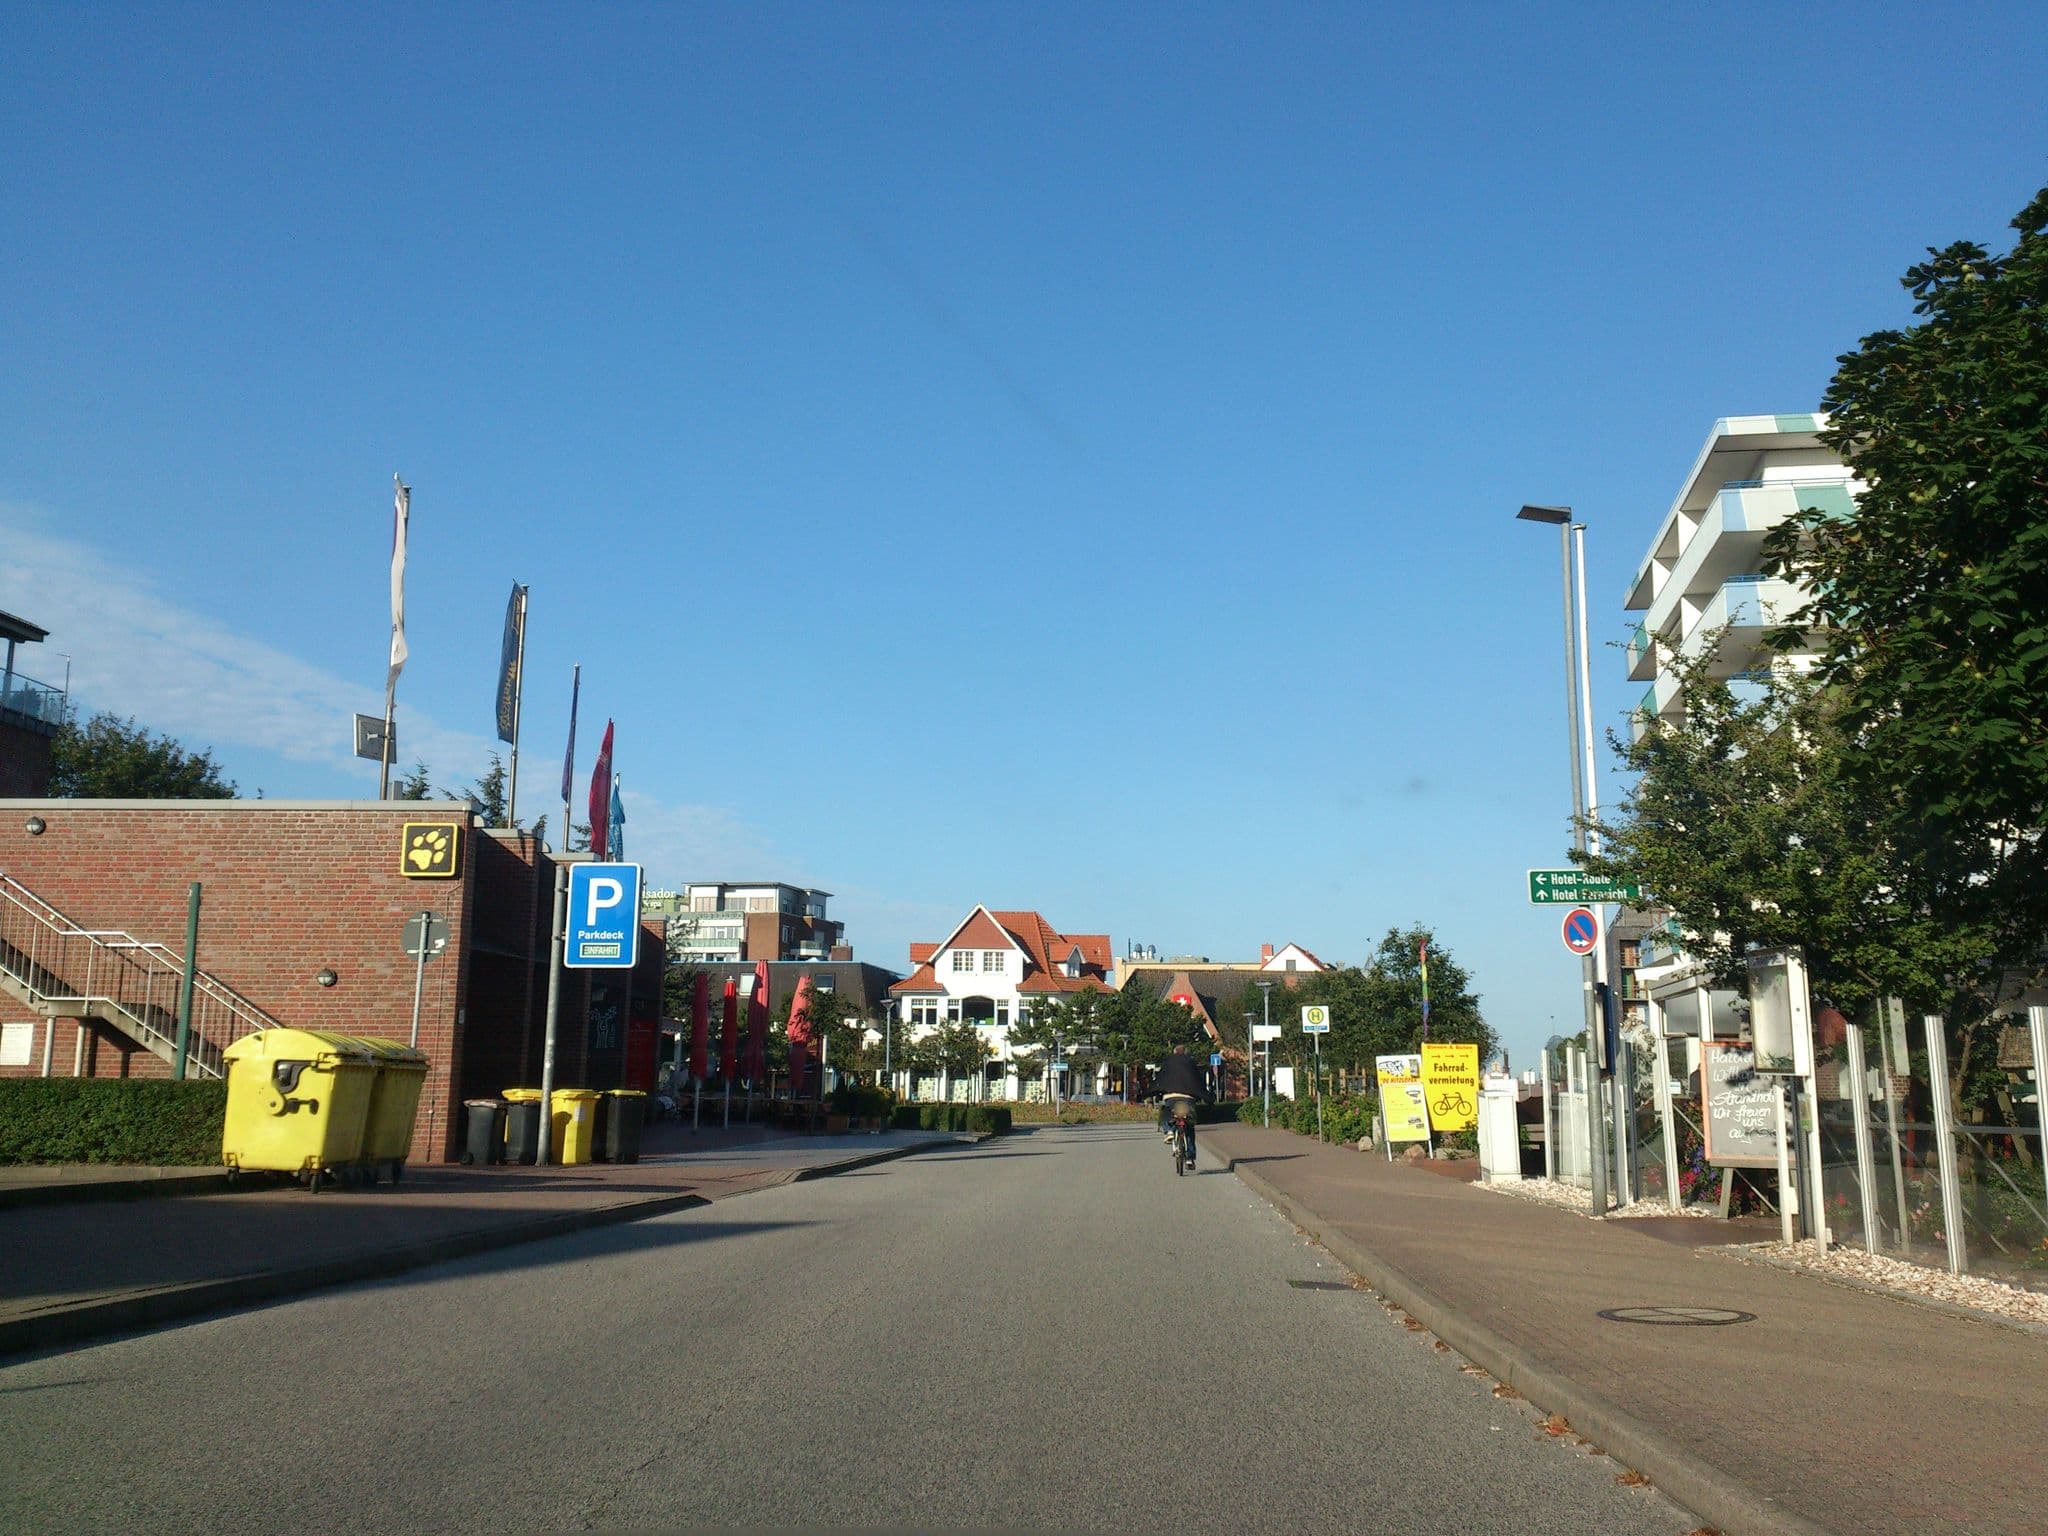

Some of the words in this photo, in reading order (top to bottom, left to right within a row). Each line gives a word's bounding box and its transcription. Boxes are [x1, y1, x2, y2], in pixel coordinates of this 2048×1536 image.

[1552, 888, 1578, 900] Hotel
[586, 877, 623, 927] P
[577, 930, 624, 940] Parkdeck
[1434, 1063, 1469, 1073] Fahrrad-
[1428, 1076, 1475, 1087] vermietung
[1713, 1107, 1731, 1120] Wir
[1733, 1104, 1771, 1123] freuen
[1742, 1117, 1765, 1127] uns
